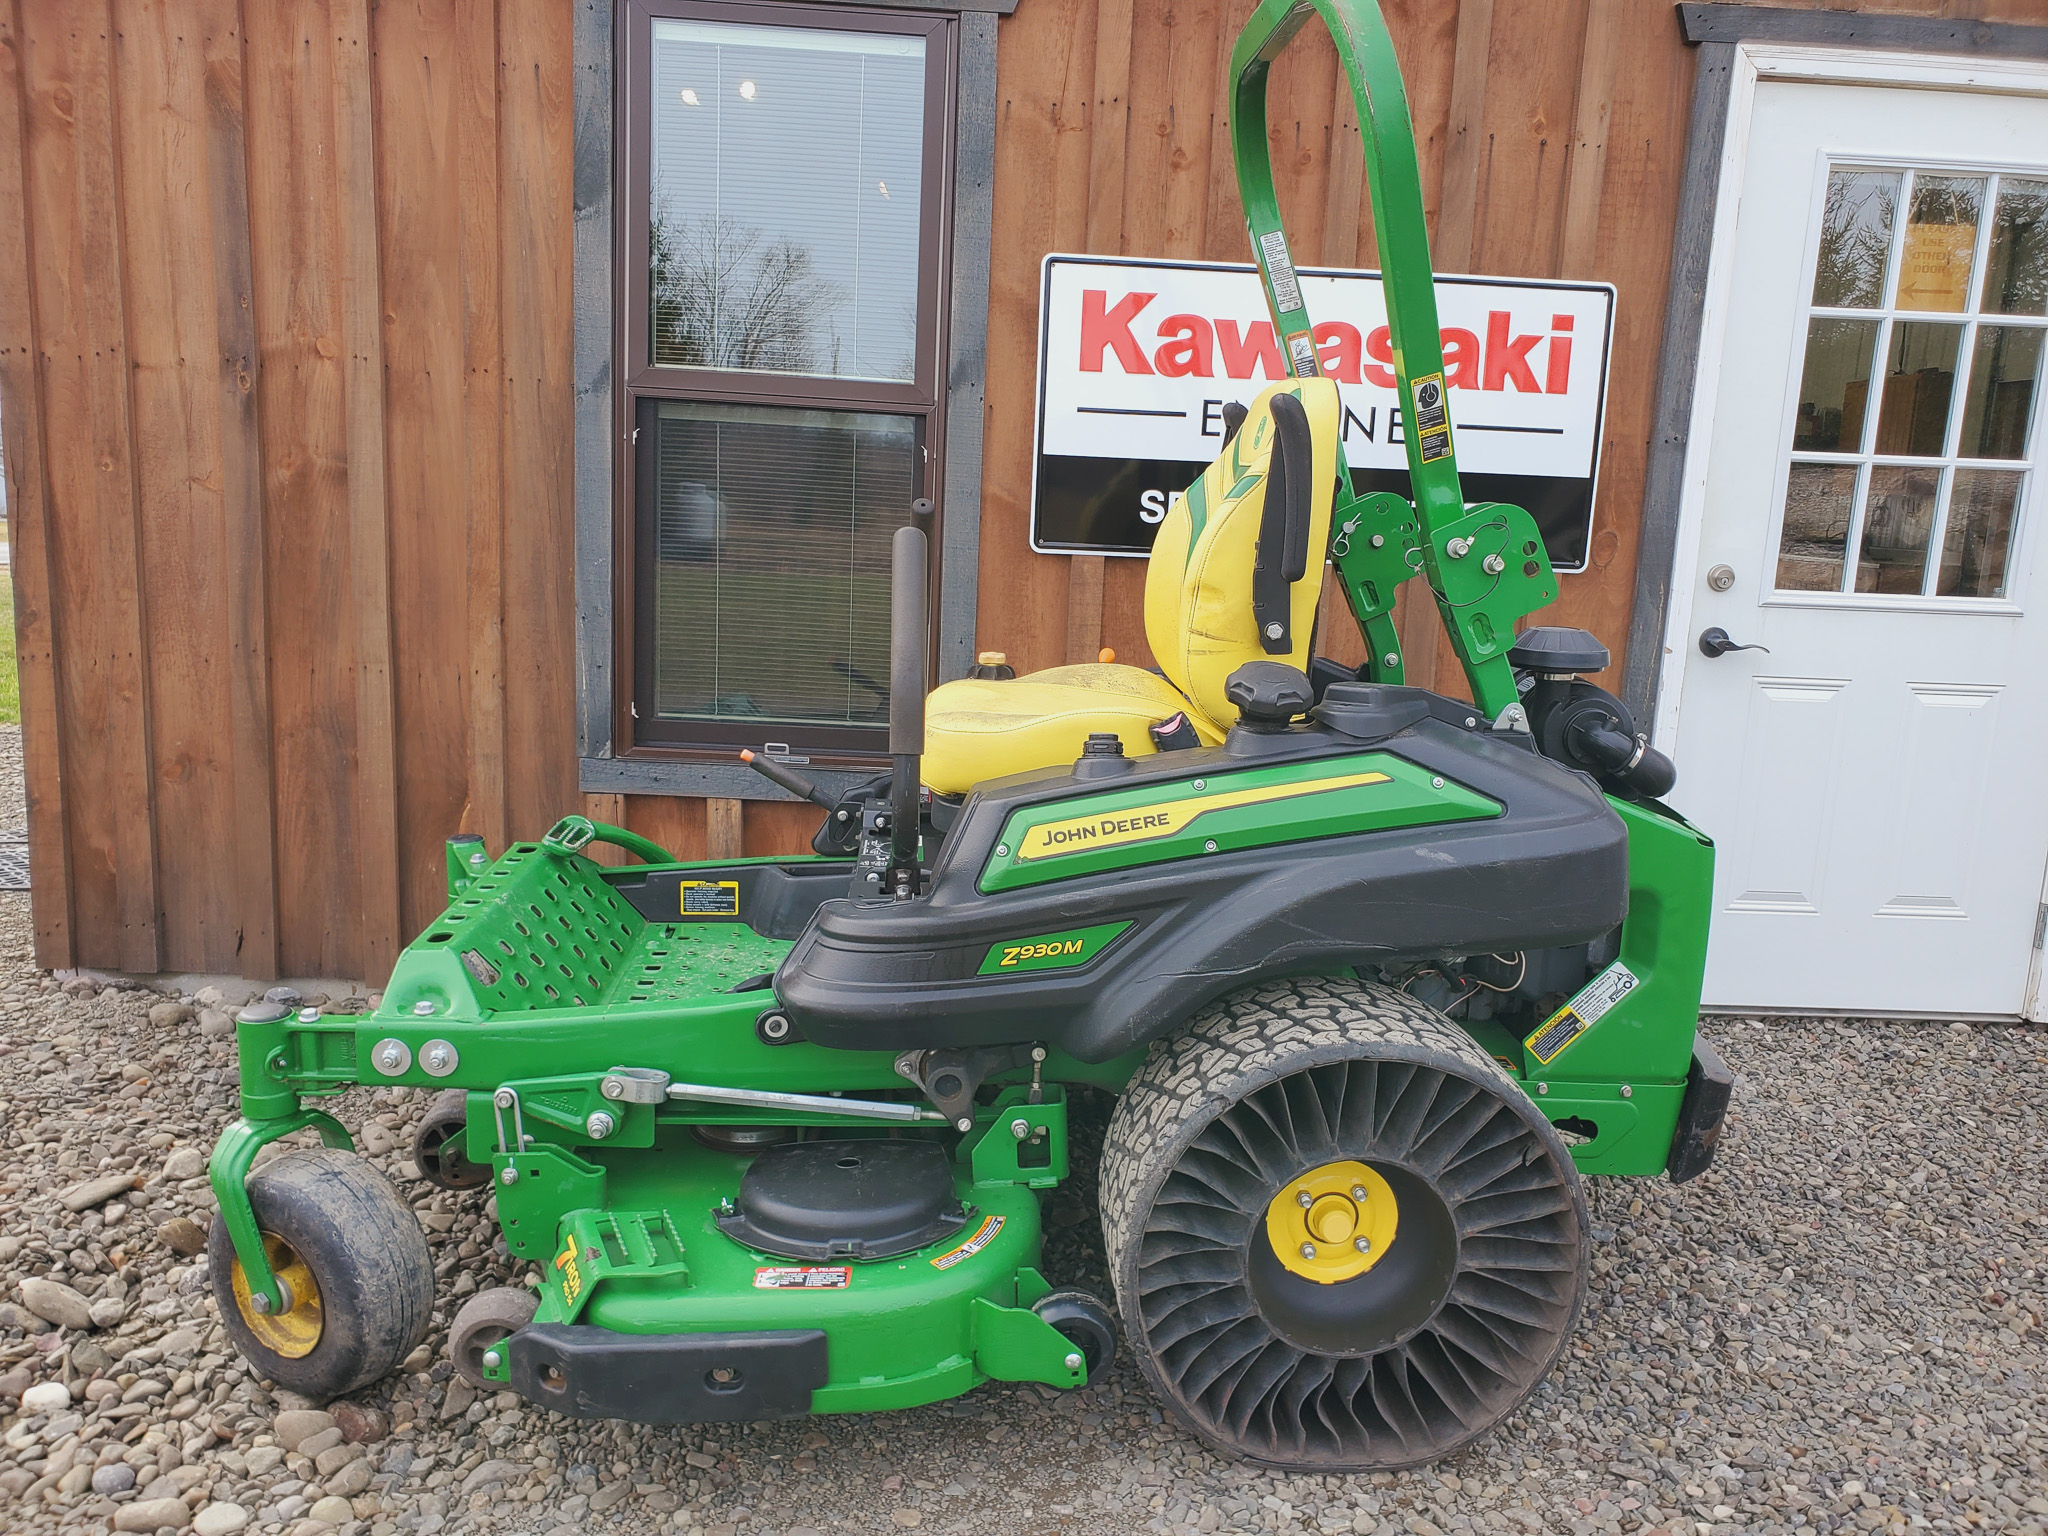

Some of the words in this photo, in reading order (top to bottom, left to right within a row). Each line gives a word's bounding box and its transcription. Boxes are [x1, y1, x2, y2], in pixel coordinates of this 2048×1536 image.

[1912, 225, 1956, 233] PLEAS
[1922, 238, 1944, 247] USE
[1913, 264, 1947, 273] DOOR
[1079, 289, 1575, 395] Kawasaki
[1418, 374, 1439, 384] CAUTION
[1042, 825, 1097, 847] JOHN
[1100, 812, 1170, 836] DEERE
[1000, 939, 1083, 967] Z930M
[1538, 1014, 1563, 1037] ATENCIÓN
